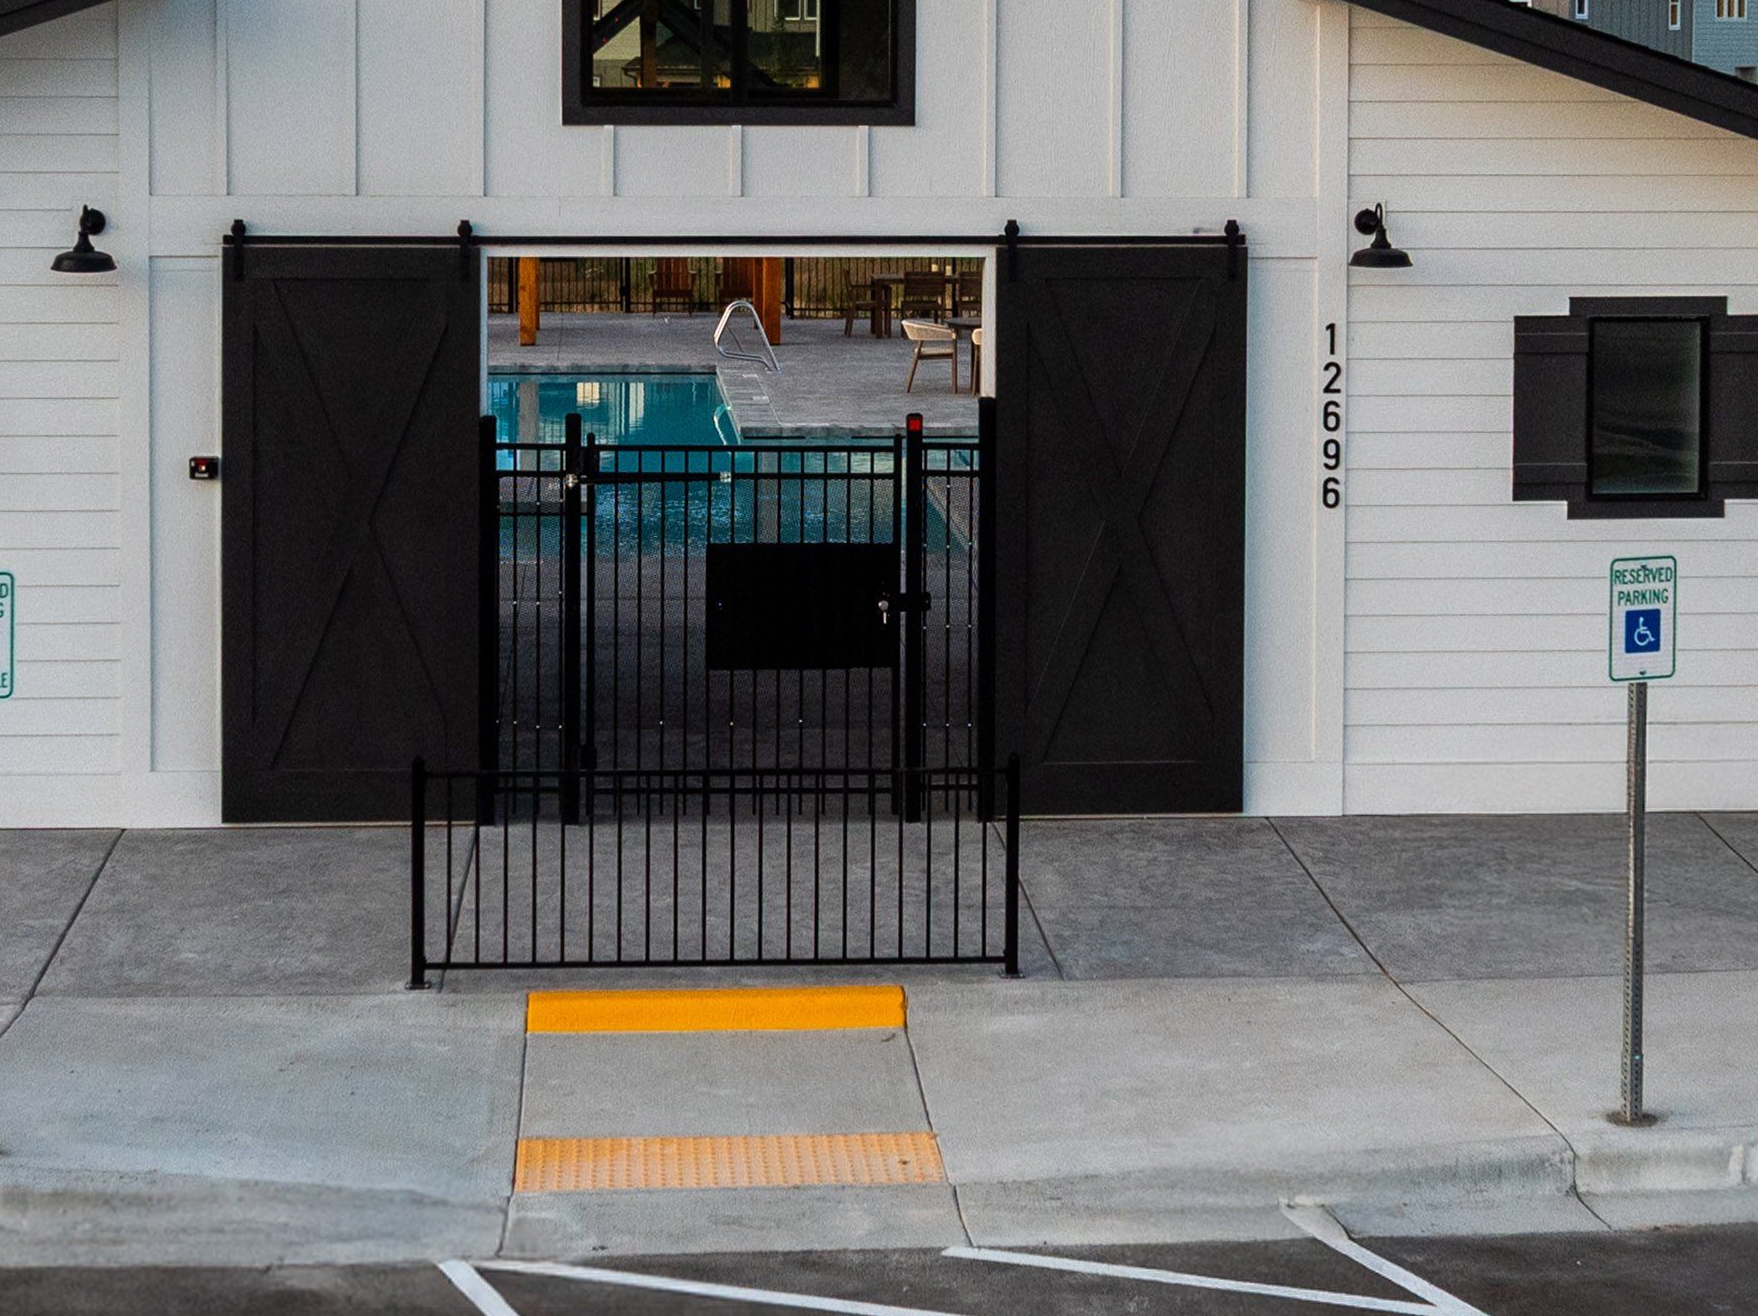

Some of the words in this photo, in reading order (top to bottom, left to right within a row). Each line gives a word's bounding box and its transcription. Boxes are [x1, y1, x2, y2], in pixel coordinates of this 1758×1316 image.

[1322, 322, 1342, 509] 12696
[1613, 567, 1673, 585] RESERVED
[1618, 588, 1669, 606] PARKING
